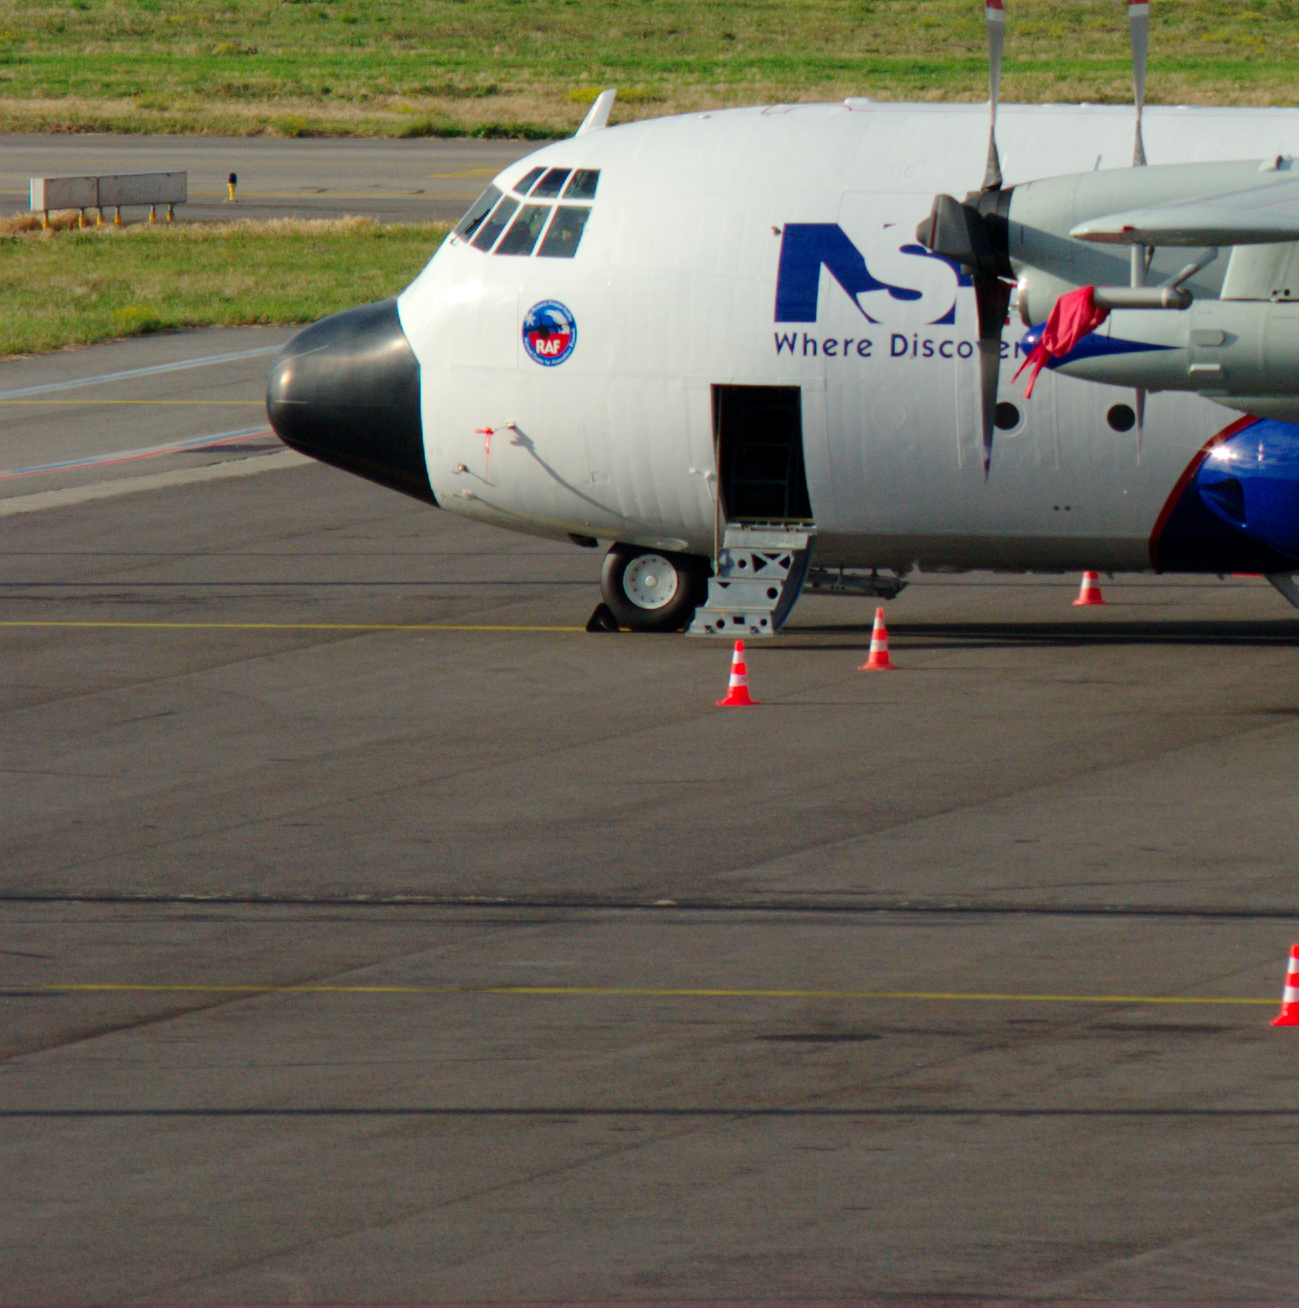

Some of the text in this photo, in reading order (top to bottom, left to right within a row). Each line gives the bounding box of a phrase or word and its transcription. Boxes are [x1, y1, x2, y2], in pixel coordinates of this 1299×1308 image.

[774, 222, 975, 325] NS
[535, 339, 561, 355] RAF
[774, 332, 1021, 358] Where Discoer
